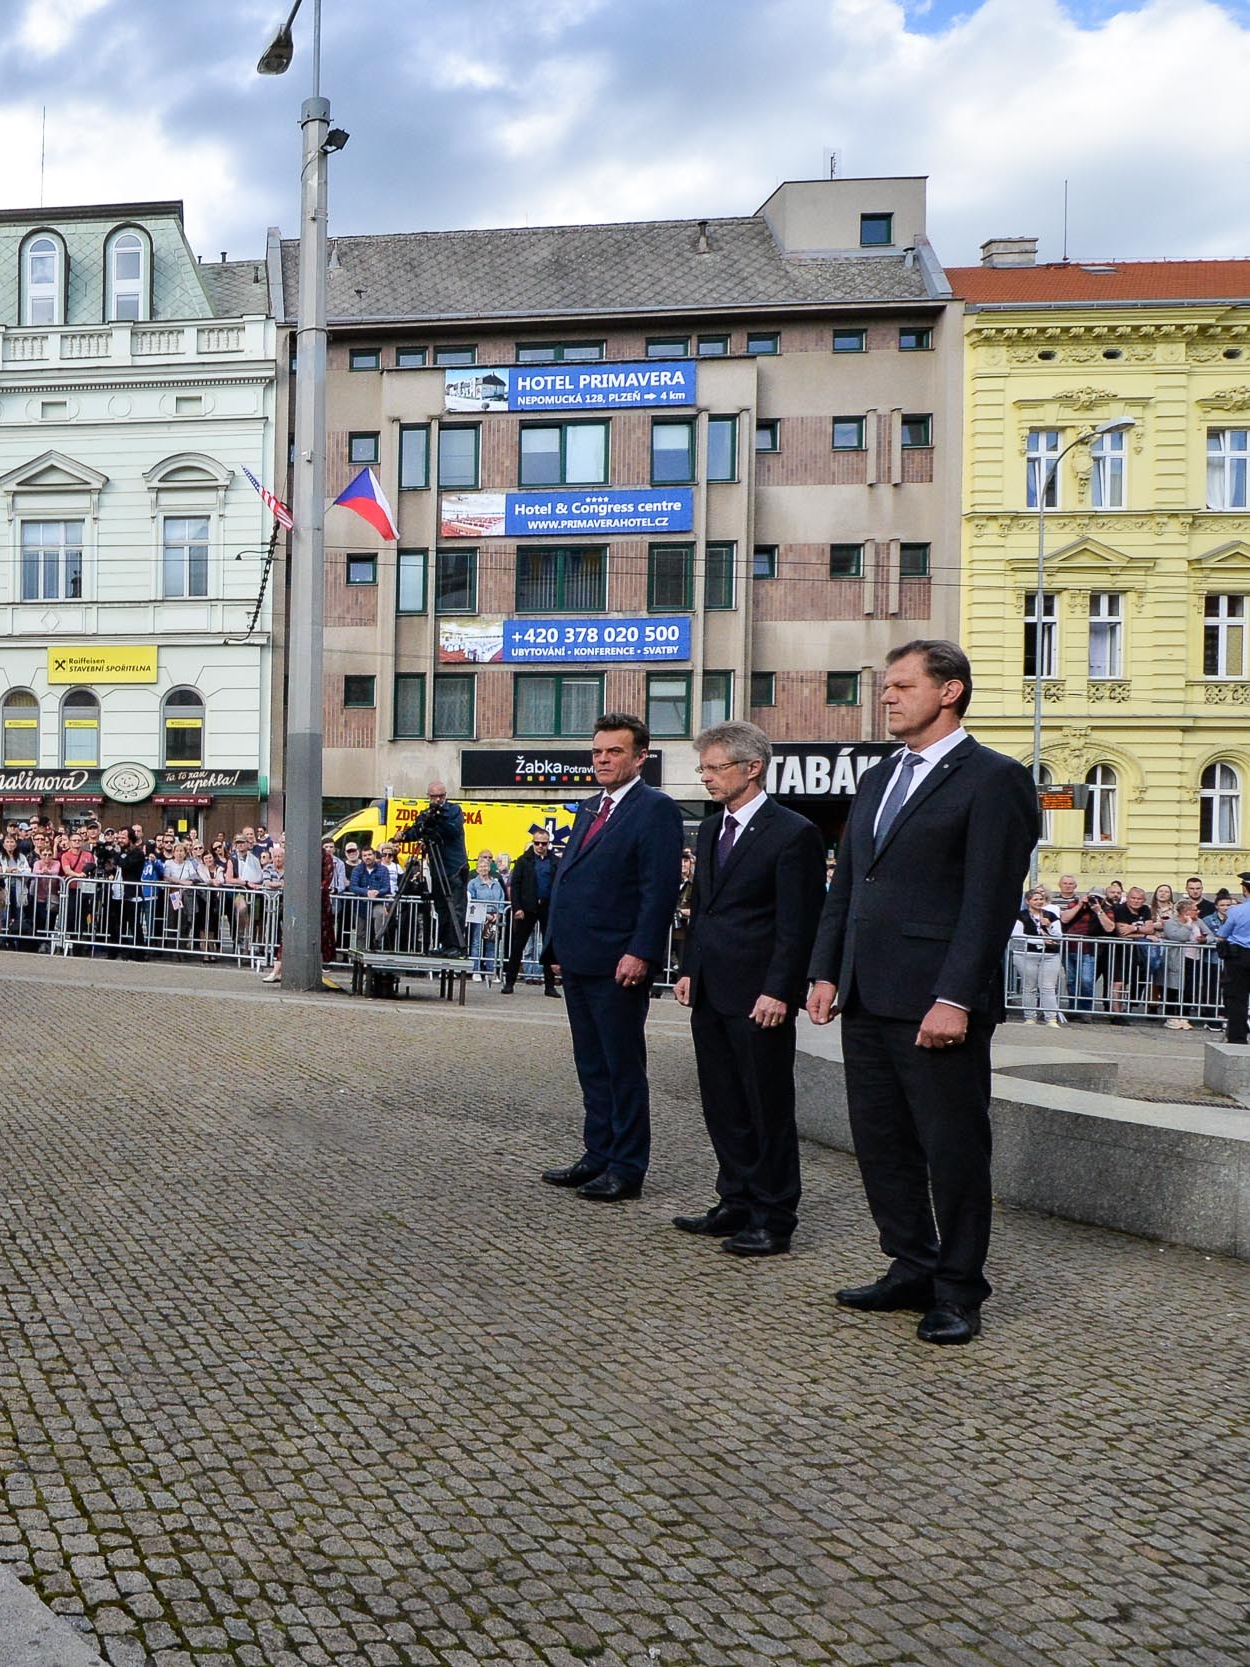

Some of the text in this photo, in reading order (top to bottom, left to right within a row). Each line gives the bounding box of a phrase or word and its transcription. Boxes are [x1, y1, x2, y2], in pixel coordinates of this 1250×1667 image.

[517, 371, 685, 391] HOTEL PRIMAVERA
[517, 390, 686, 405] NEPOMUCKÁ 128, PLZEŇ 4 km
[514, 500, 682, 517] Hotel & Congress centre
[527, 517, 669, 530] WWW.PRIMAVERAHOTEL.CZ
[512, 625, 680, 643] +420 378 020 500
[511, 645, 679, 656] UBYTOVÁNÍ KONFERENCE SVATBY
[68, 657, 106, 665] Raiffeisen
[68, 663, 152, 672] STAVEBNÍ SPOŘITELNA
[515, 755, 562, 774] Žabka
[180, 770, 240, 794] upekla!
